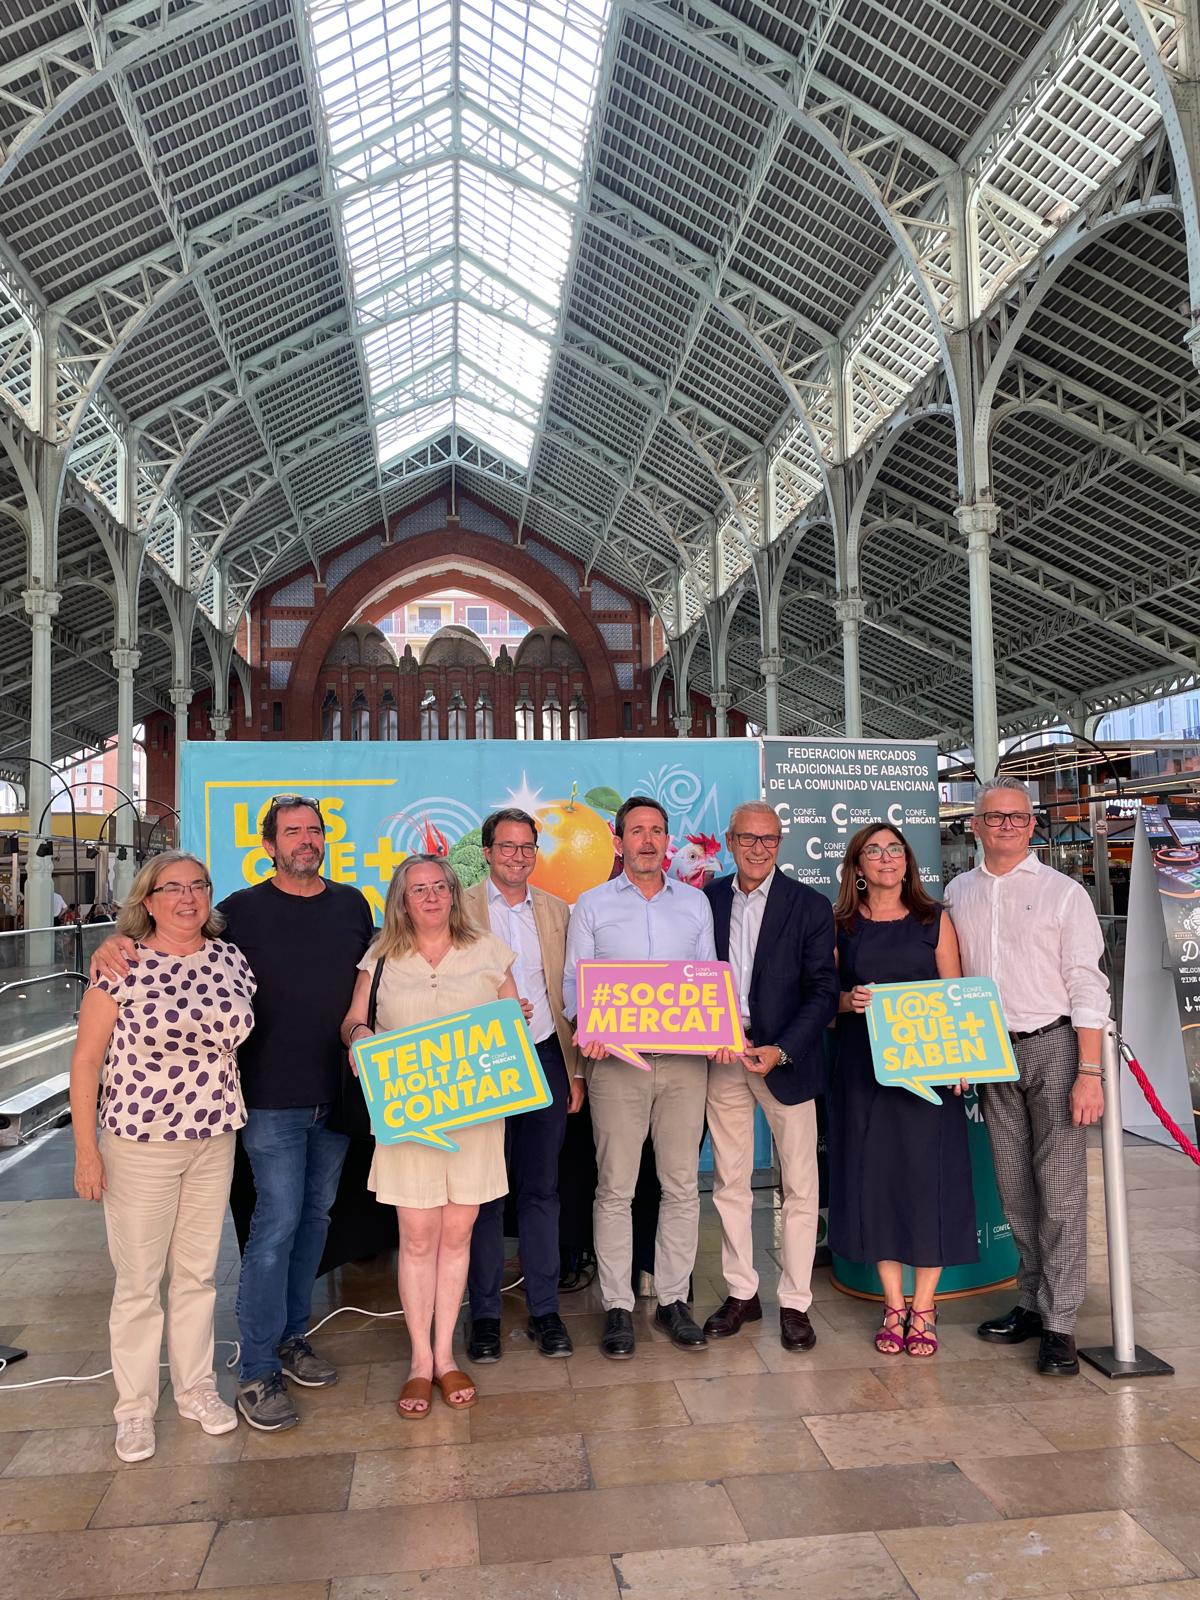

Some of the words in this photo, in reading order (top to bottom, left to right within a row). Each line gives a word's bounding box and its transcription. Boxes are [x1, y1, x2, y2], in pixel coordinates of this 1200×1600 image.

[788, 747, 856, 760] FEDERACION
[858, 750, 917, 760] MERCADOS
[776, 763, 861, 775] TRADICIONALES
[864, 765, 878, 776] DE
[881, 765, 929, 777] ABASTOS
[769, 779, 786, 790] DE
[788, 779, 802, 790] LA
[804, 779, 868, 791] COMUNIDAD
[870, 781, 935, 792] VALENCIANA
[793, 808, 816, 816] CONFE
[850, 808, 871, 816] CONFE
[905, 808, 926, 816] CONFE
[234, 793, 347, 848] LS
[793, 816, 827, 824] MERCATS
[850, 816, 882, 824] MERCATS
[905, 816, 936, 824] MERCATS
[824, 842, 846, 850] CONFE
[824, 850, 846, 858] MERC
[242, 842, 357, 886] QE
[798, 868, 820, 876] CONFE
[798, 876, 831, 884] MERCATS
[963, 991, 992, 999] MERCATS
[882, 991, 948, 1024] L@S
[586, 1007, 726, 1033] MERCAT
[891, 1016, 957, 1044] QUE
[370, 1019, 506, 1081] TENIM
[882, 1037, 987, 1071] SABEN
[492, 1054, 517, 1065] MERCATS
[384, 1065, 450, 1101] MOLT
[456, 1058, 475, 1081] A
[383, 1067, 523, 1129] CONTAR
